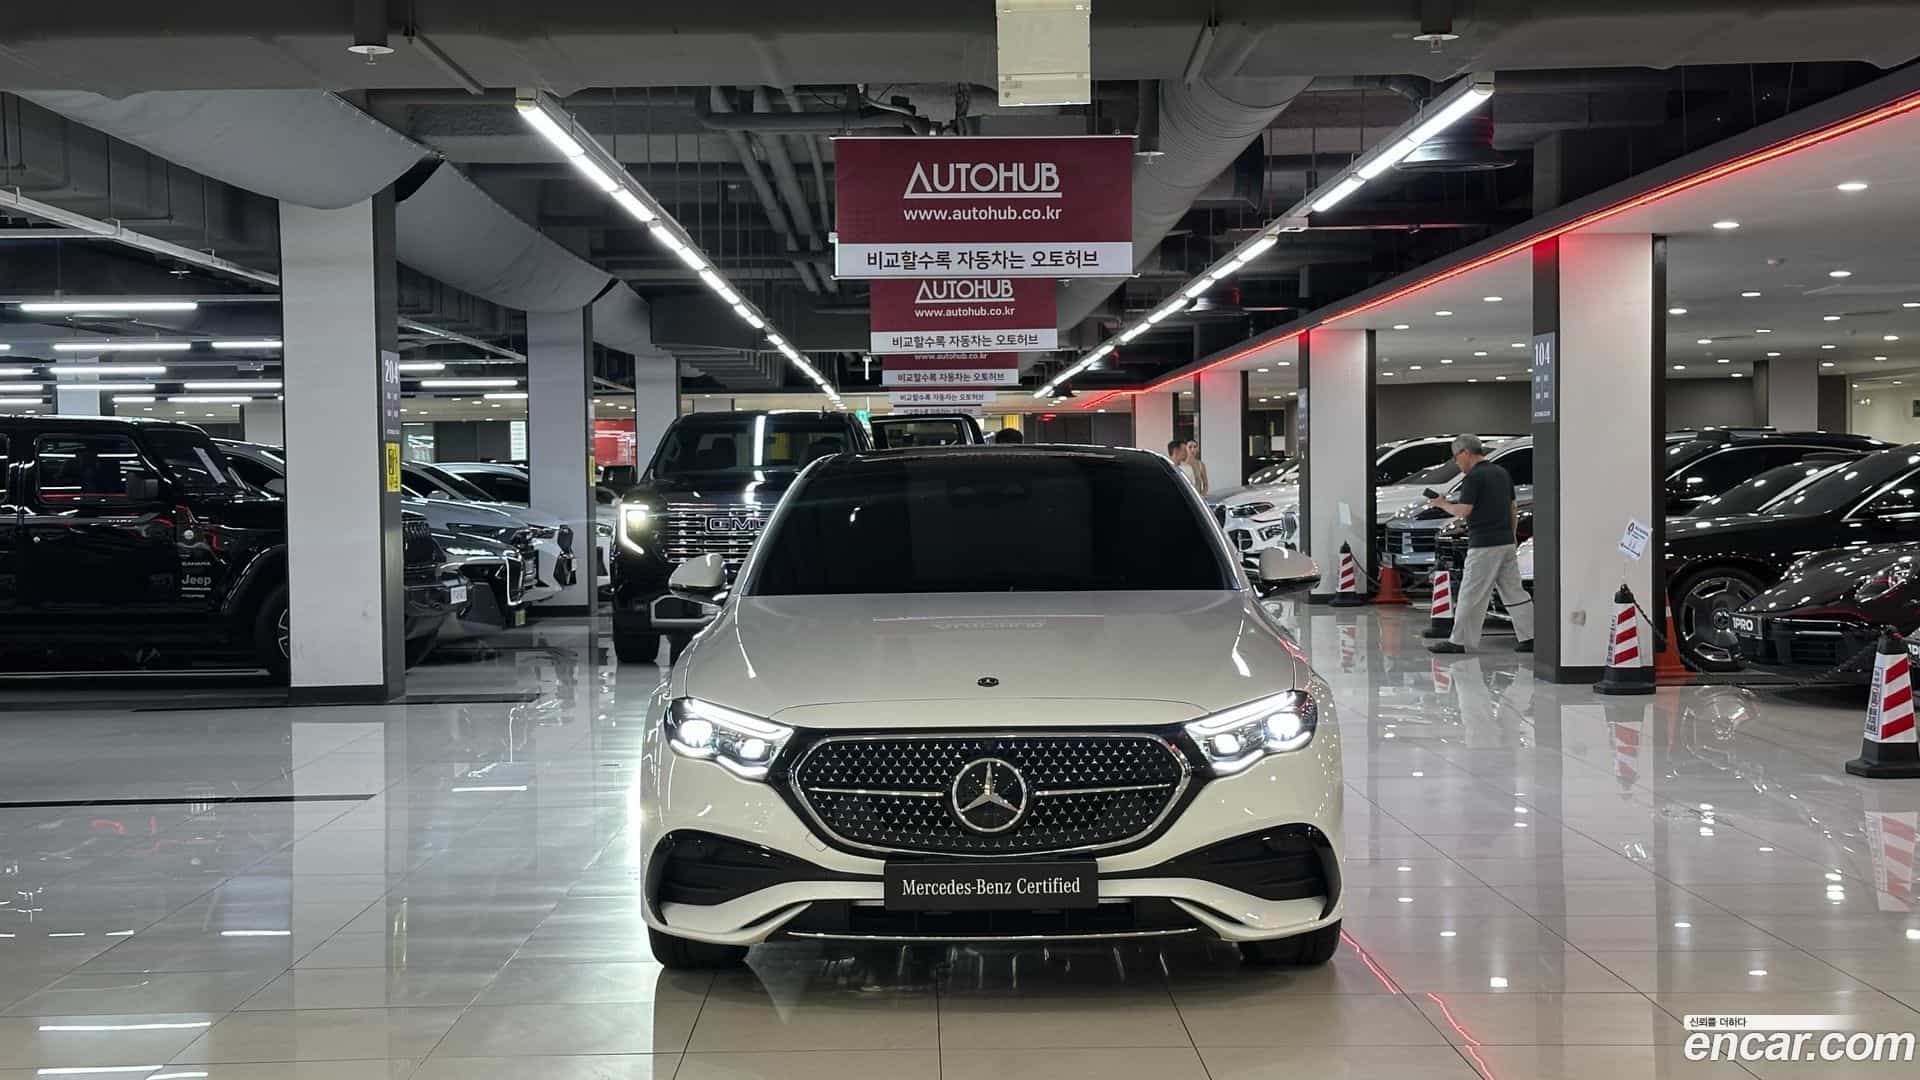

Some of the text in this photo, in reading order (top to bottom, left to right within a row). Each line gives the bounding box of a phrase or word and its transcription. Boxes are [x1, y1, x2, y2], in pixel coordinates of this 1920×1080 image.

[904, 161, 1062, 198] AUTOHUB
[904, 206, 1062, 220] www.autohub.co.kr
[867, 250, 1099, 270] 비교할수록 자동차는 오토허브
[915, 280, 1015, 303] AUTOHUB
[915, 306, 1015, 317] www.autohub.co.kr
[892, 334, 1039, 348] 비교할수록 자동차는 오토허브
[1535, 341, 1551, 366] 104
[384, 359, 399, 384] 204
[181, 574, 212, 586] Jeep
[902, 877, 1080, 896] Mercedes-Benz Certified
